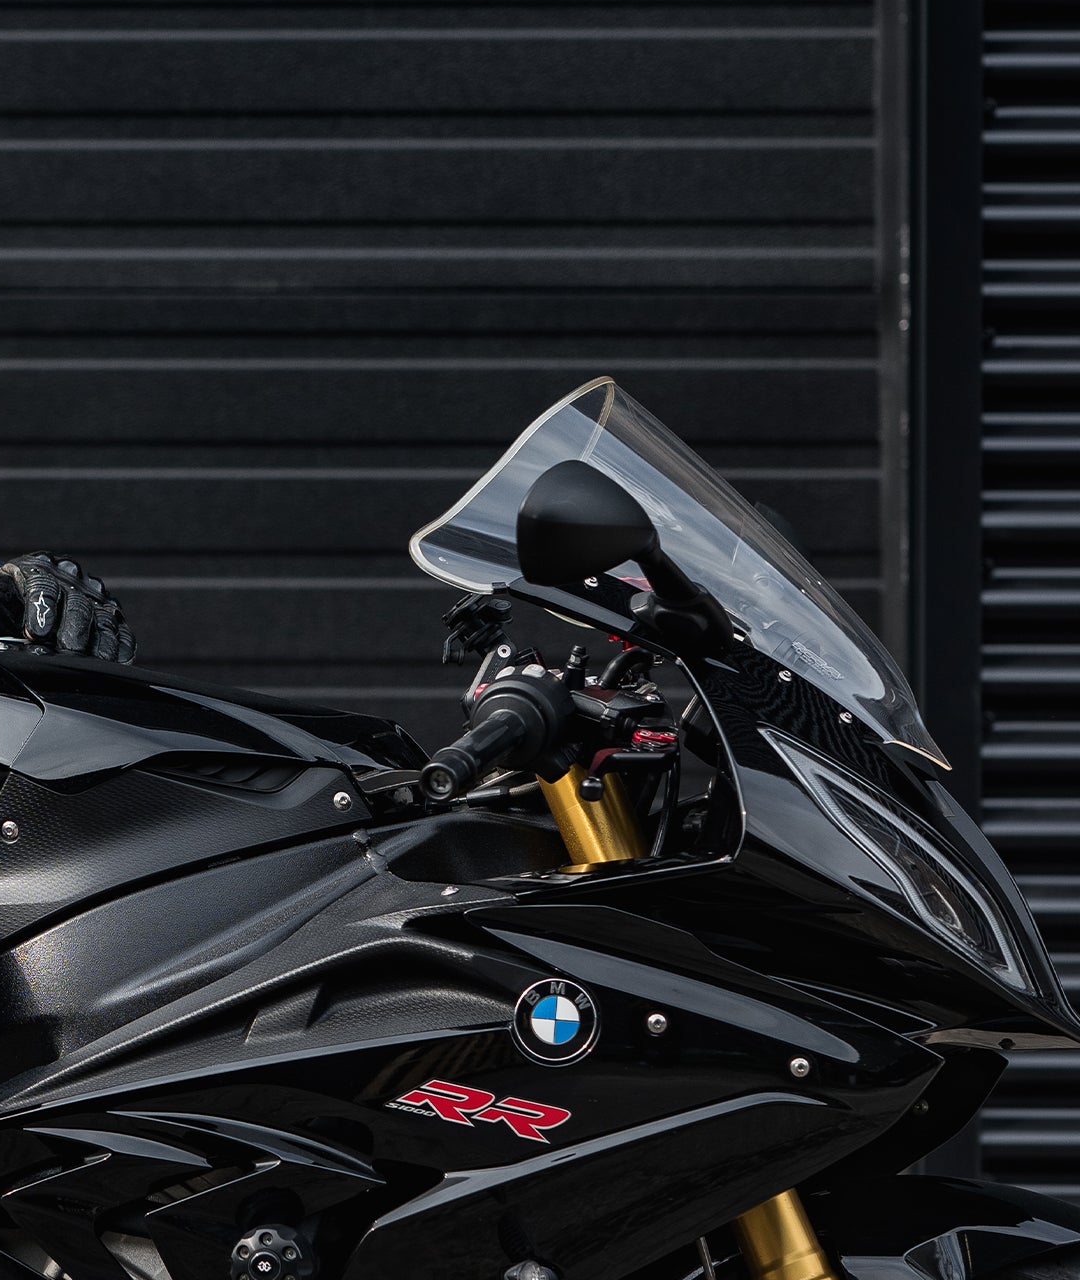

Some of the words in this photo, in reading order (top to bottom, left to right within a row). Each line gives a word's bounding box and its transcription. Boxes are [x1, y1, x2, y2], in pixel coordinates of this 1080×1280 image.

[524, 981, 591, 1010] BMW
[384, 1101, 438, 1117] S1000
[395, 1079, 572, 1145] RR
